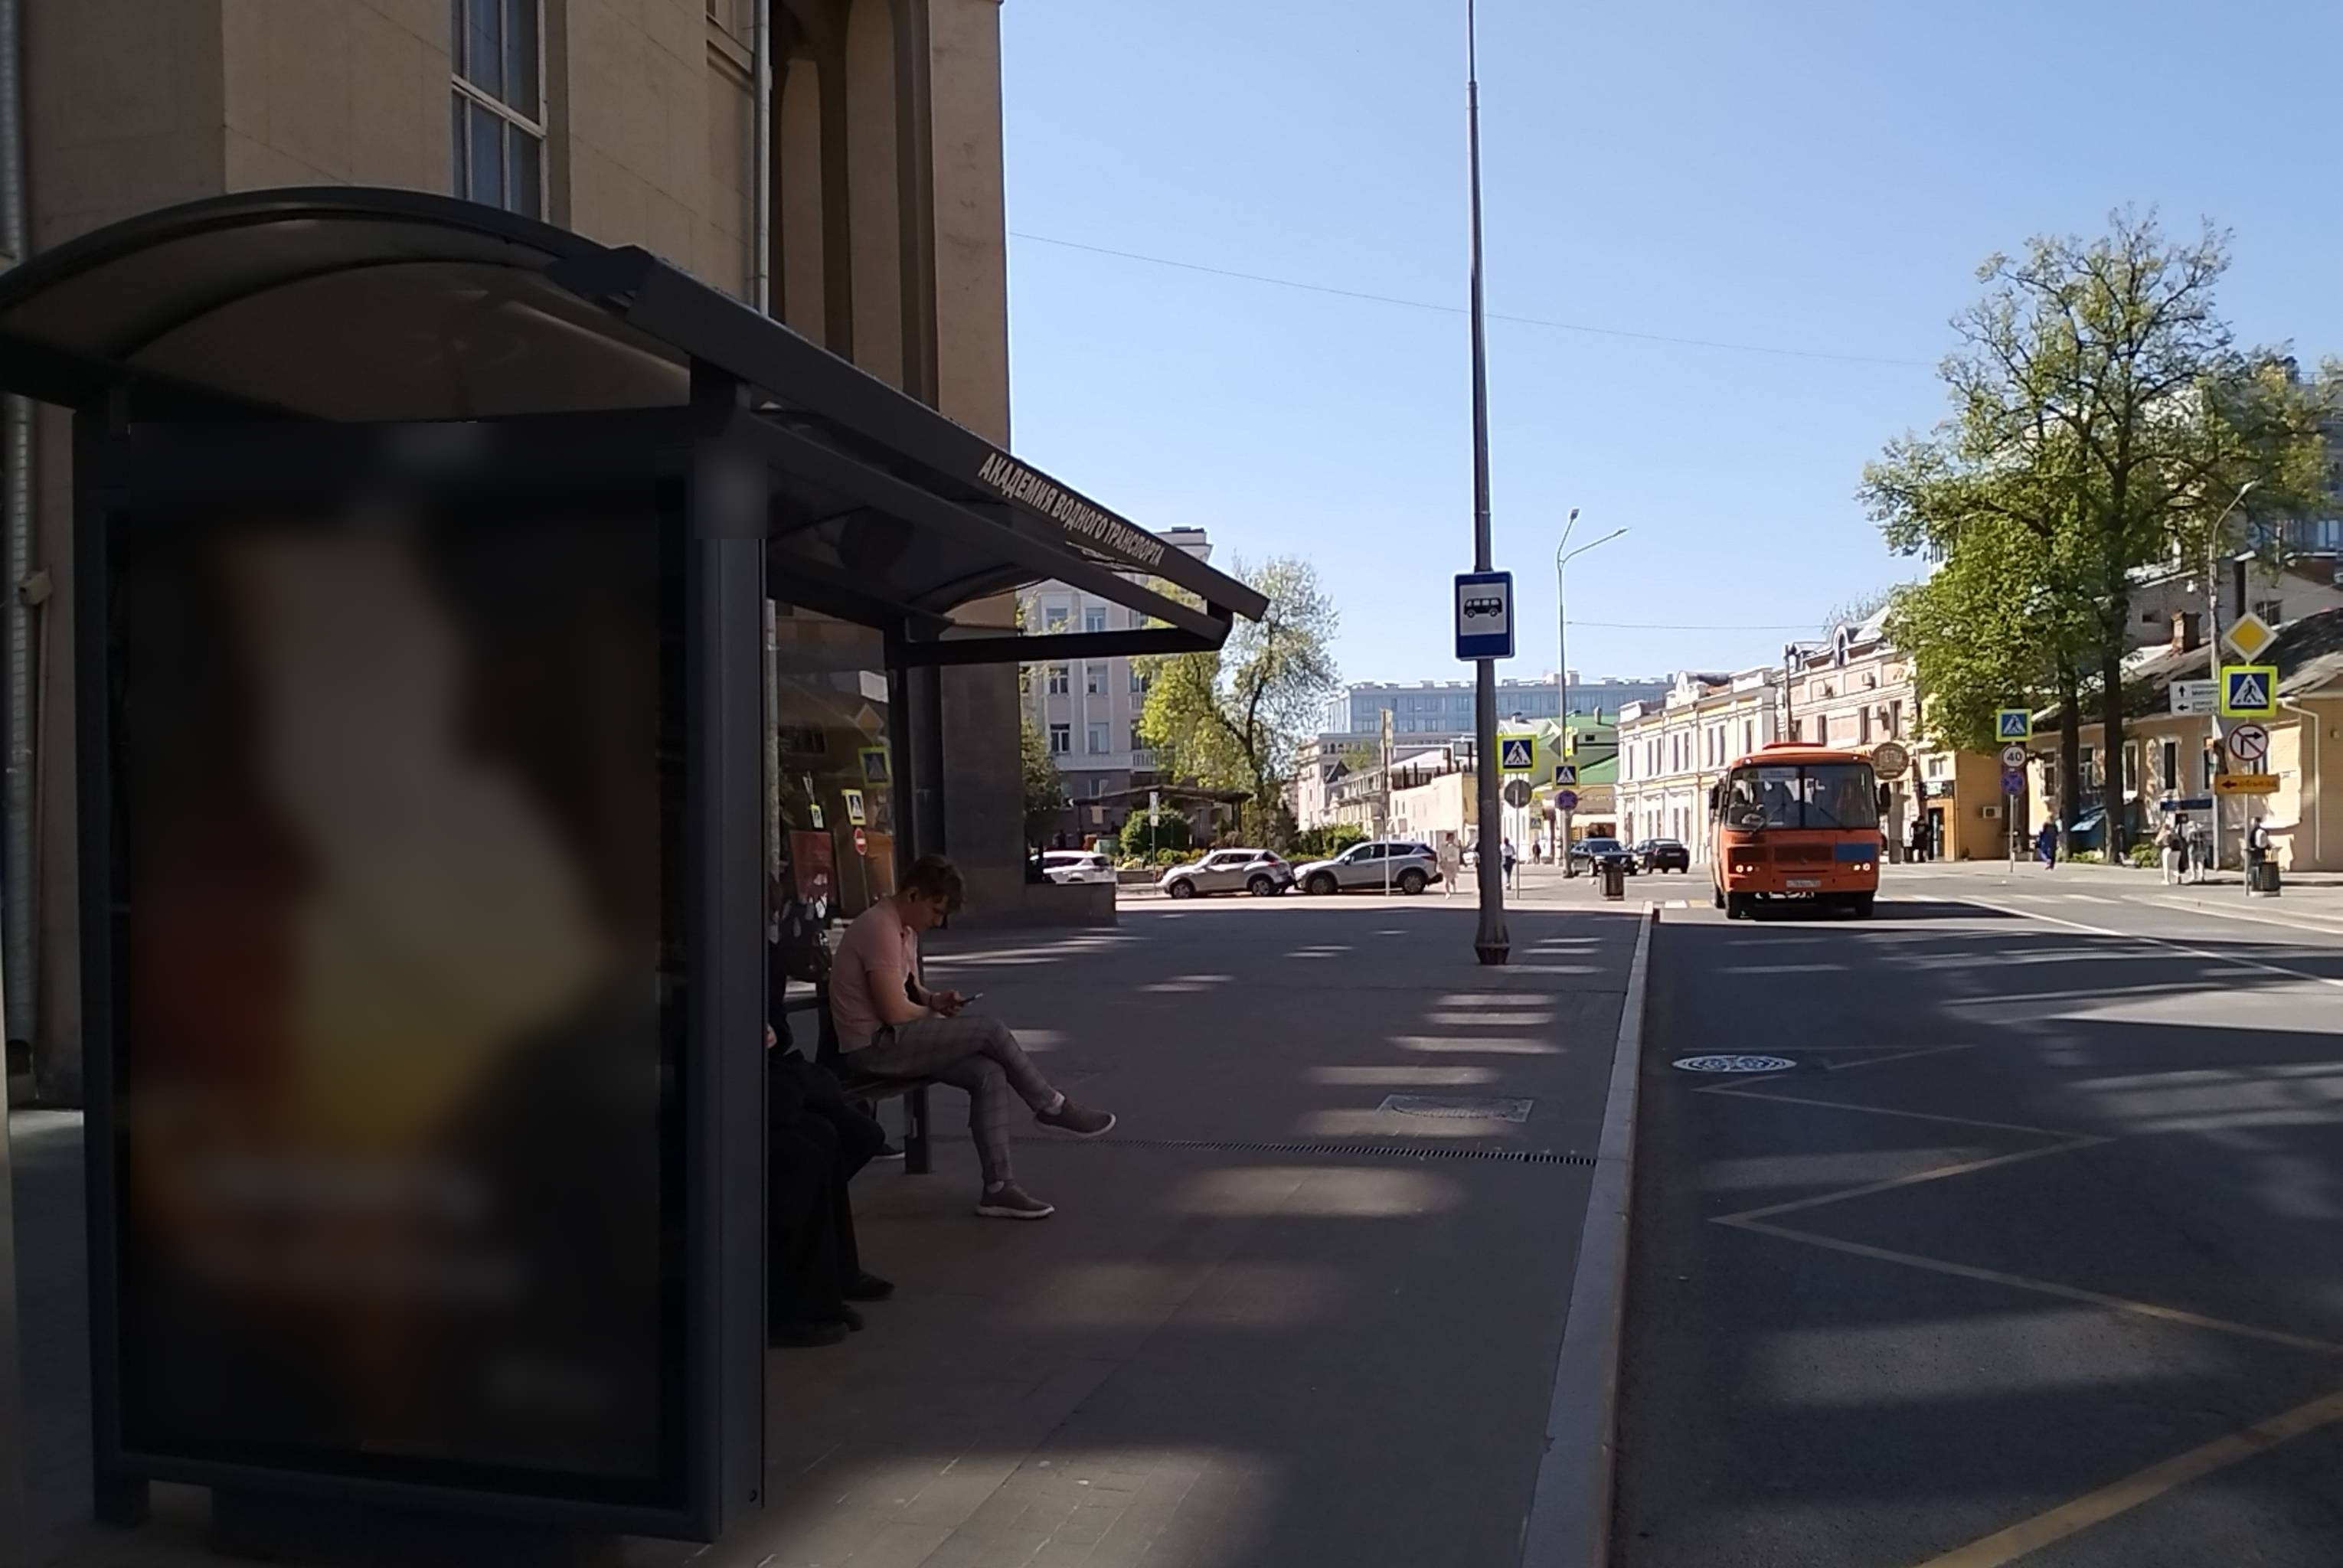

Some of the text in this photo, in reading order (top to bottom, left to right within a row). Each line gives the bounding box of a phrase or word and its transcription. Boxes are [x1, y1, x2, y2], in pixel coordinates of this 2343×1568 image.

[979, 453, 1165, 567] АКАДЕМИЯ ВОДНОГО ТРАНСПОРТА
[2007, 752, 2022, 761] 40
